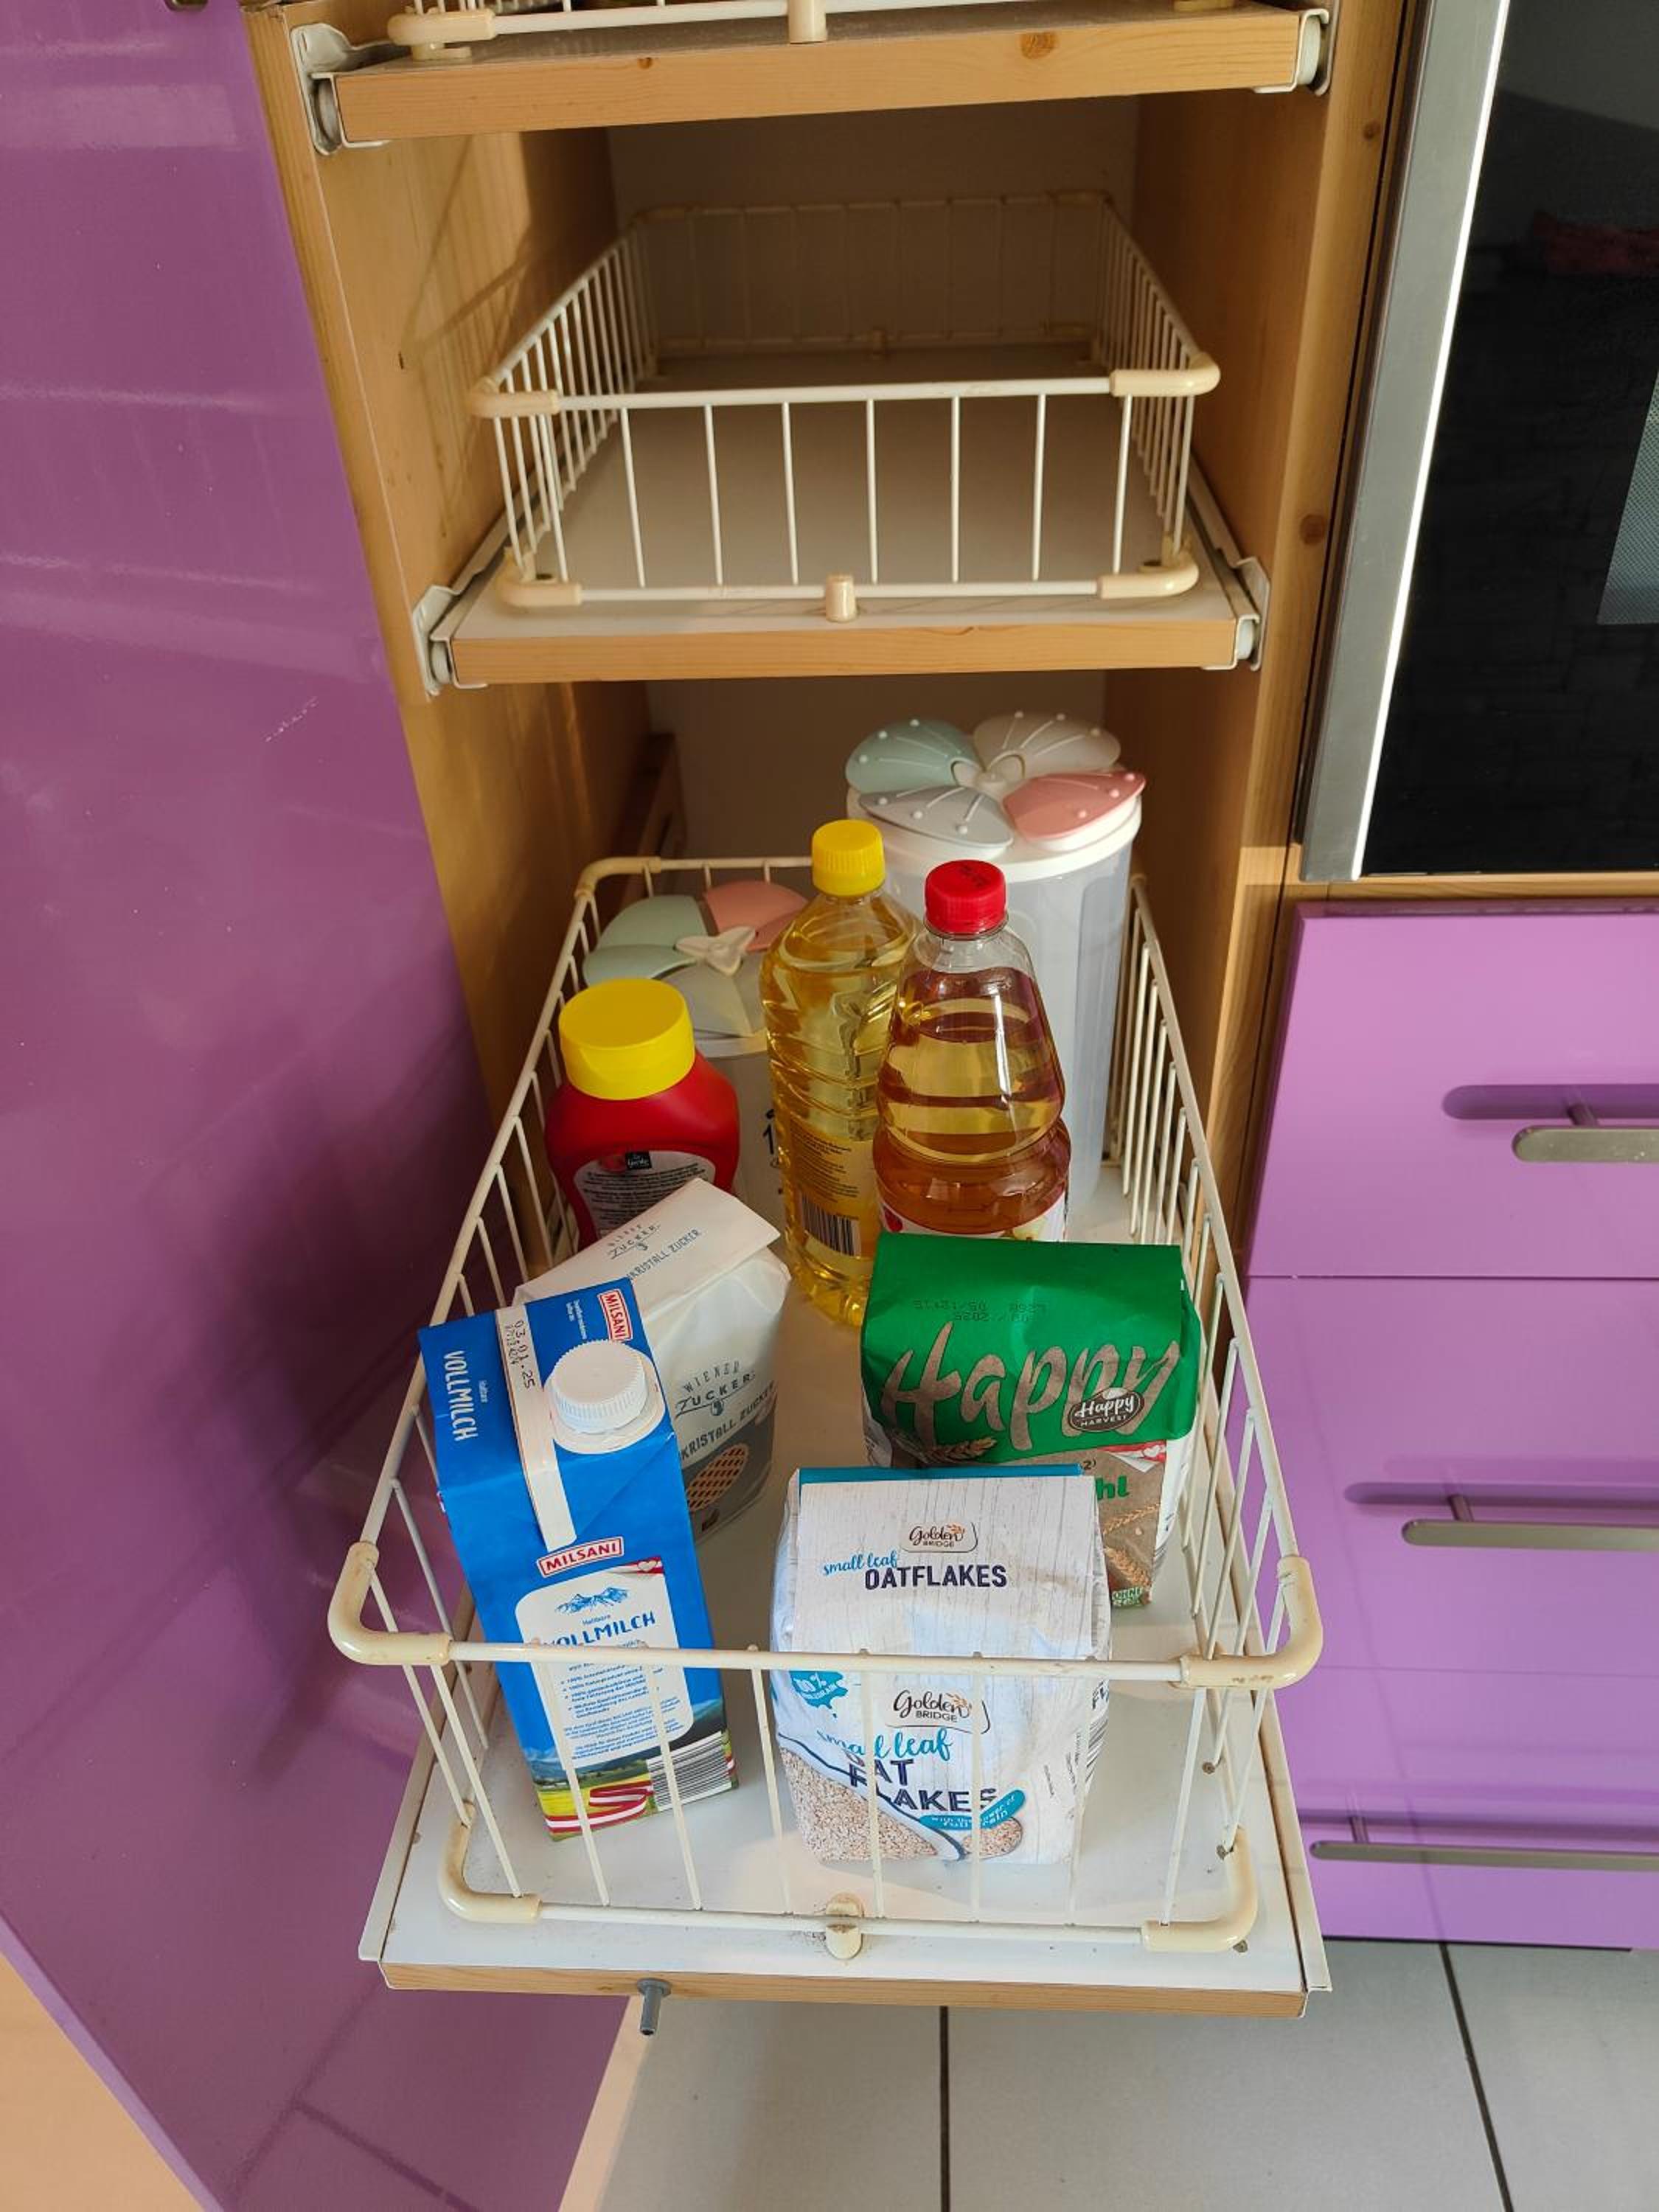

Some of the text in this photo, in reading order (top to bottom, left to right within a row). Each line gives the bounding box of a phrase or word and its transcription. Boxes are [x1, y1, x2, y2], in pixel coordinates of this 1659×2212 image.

[668, 1228, 702, 1253] ZUCKER
[605, 1294, 627, 1338] MILSANI
[444, 1349, 479, 1441] VOLLMILCH
[881, 1321, 1180, 1452] Happy
[1074, 1395, 1135, 1418] Happy
[1080, 1415, 1127, 1427] HARVEST
[1095, 1475, 1131, 1501] hl
[909, 1526, 965, 1546] Golden
[546, 1542, 617, 1573] MILSANI
[823, 1549, 899, 1576] small leaf
[865, 1564, 1008, 1590] OATFLAKES
[548, 1611, 656, 1646] OLLMILCH
[892, 1689, 972, 1719] Golden
[915, 1709, 958, 1723] BRIDGE
[817, 1727, 953, 1761] smal leaf
